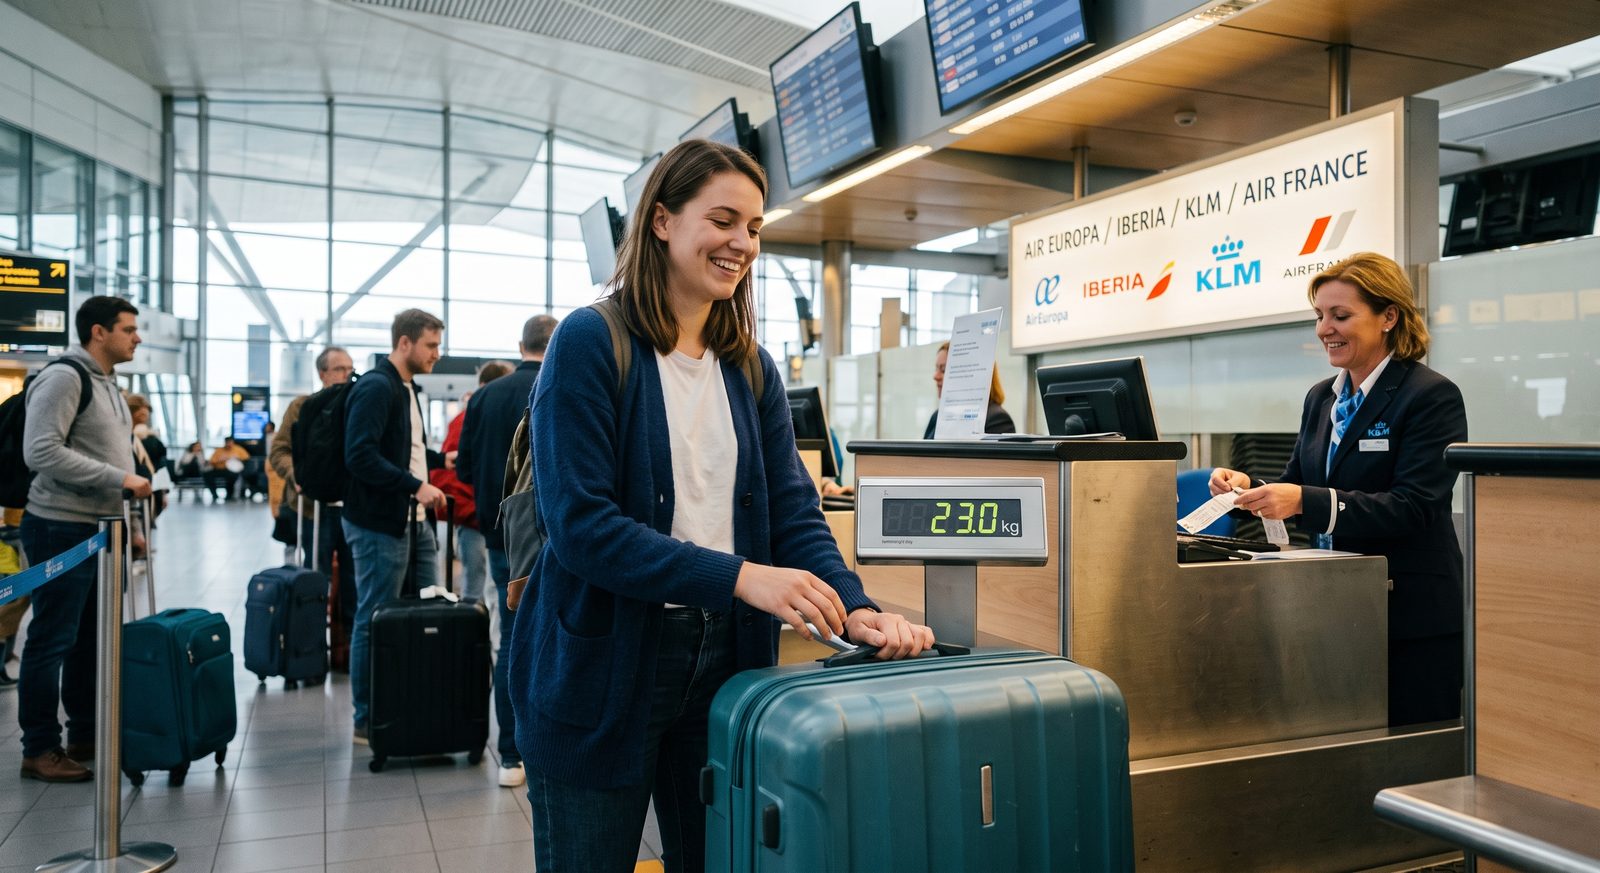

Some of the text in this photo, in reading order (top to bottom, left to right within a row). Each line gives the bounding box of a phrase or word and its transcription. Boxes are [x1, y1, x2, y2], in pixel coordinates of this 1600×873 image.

[1025, 150, 1368, 259] AIR EUROPA / IBERIA / KLM / AIR FRANCE
[1196, 259, 1261, 292] KLM
[1283, 259, 1341, 279] AIRFRA
[1083, 272, 1145, 299] IBERIA
[1025, 308, 1069, 328] AirEuropa
[930, 502, 1020, 536] 23.0 kg
